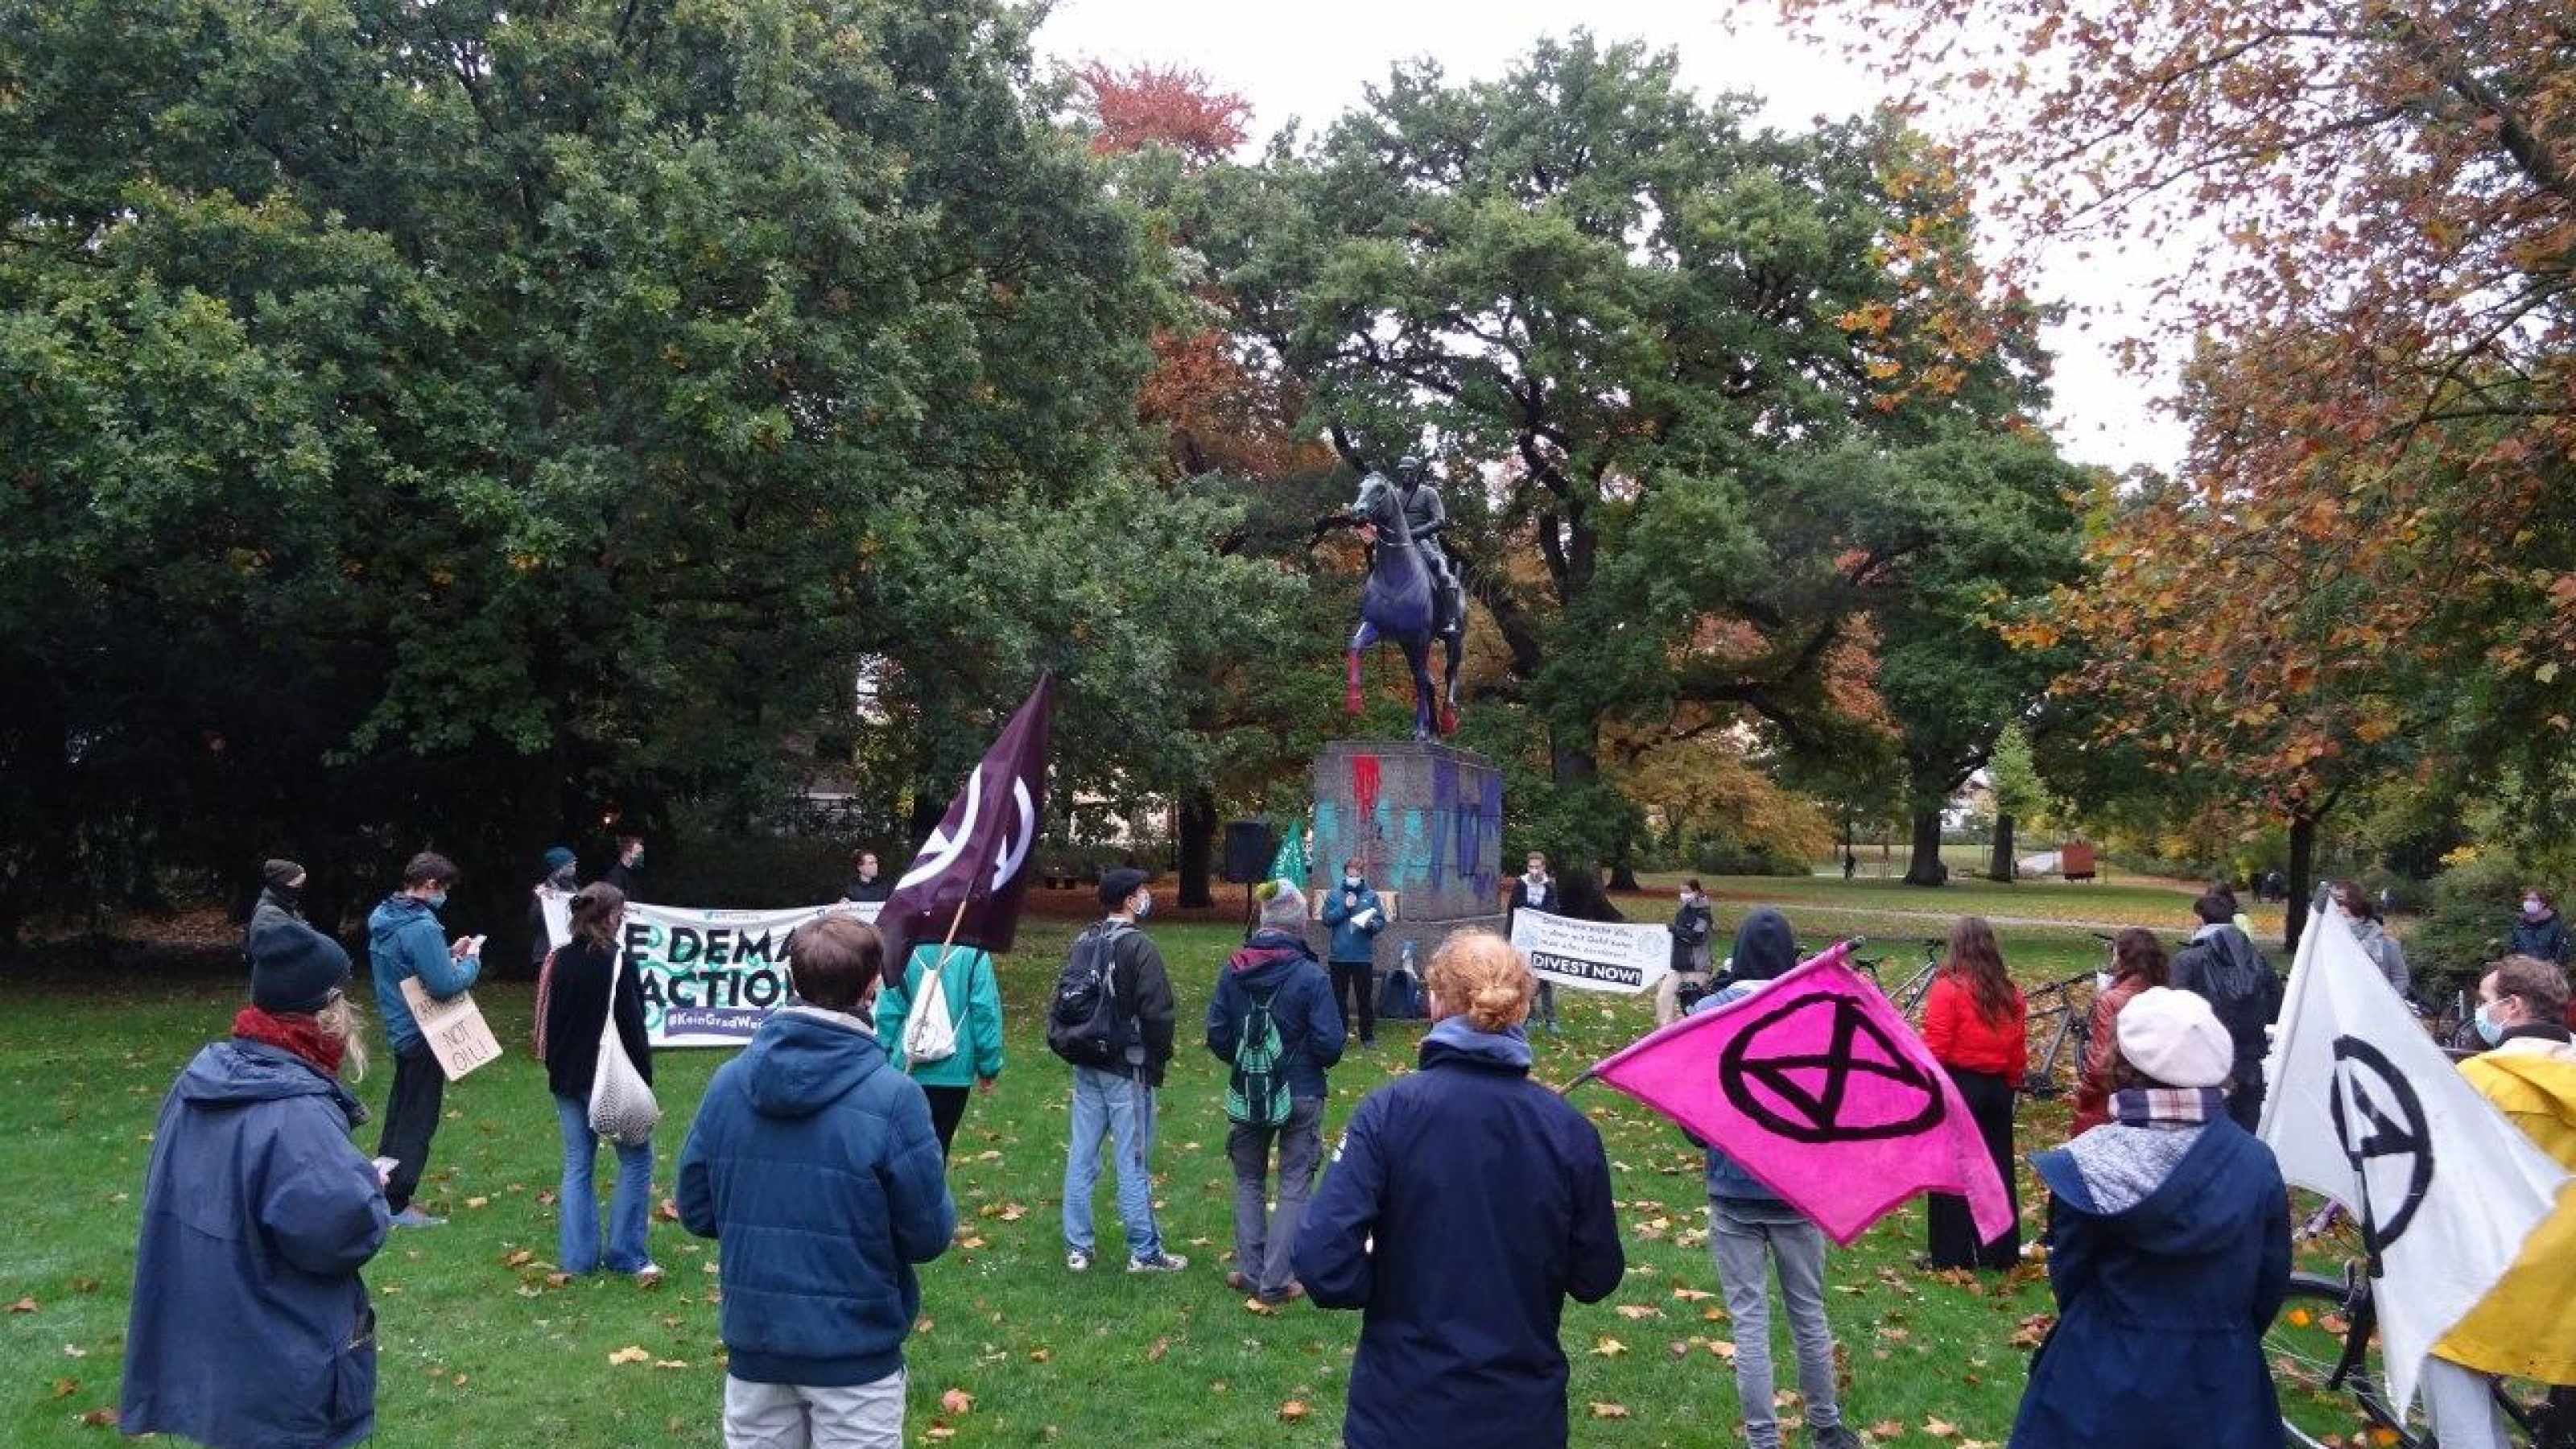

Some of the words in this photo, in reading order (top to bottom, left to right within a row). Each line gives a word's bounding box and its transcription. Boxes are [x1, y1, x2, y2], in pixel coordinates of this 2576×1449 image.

[625, 923, 651, 960] E
[1534, 953, 1589, 976] DIVEST
[1593, 964, 1641, 986] NOW!
[437, 1019, 473, 1049] NOT
[667, 1010, 762, 1029] #KeinGradWei
